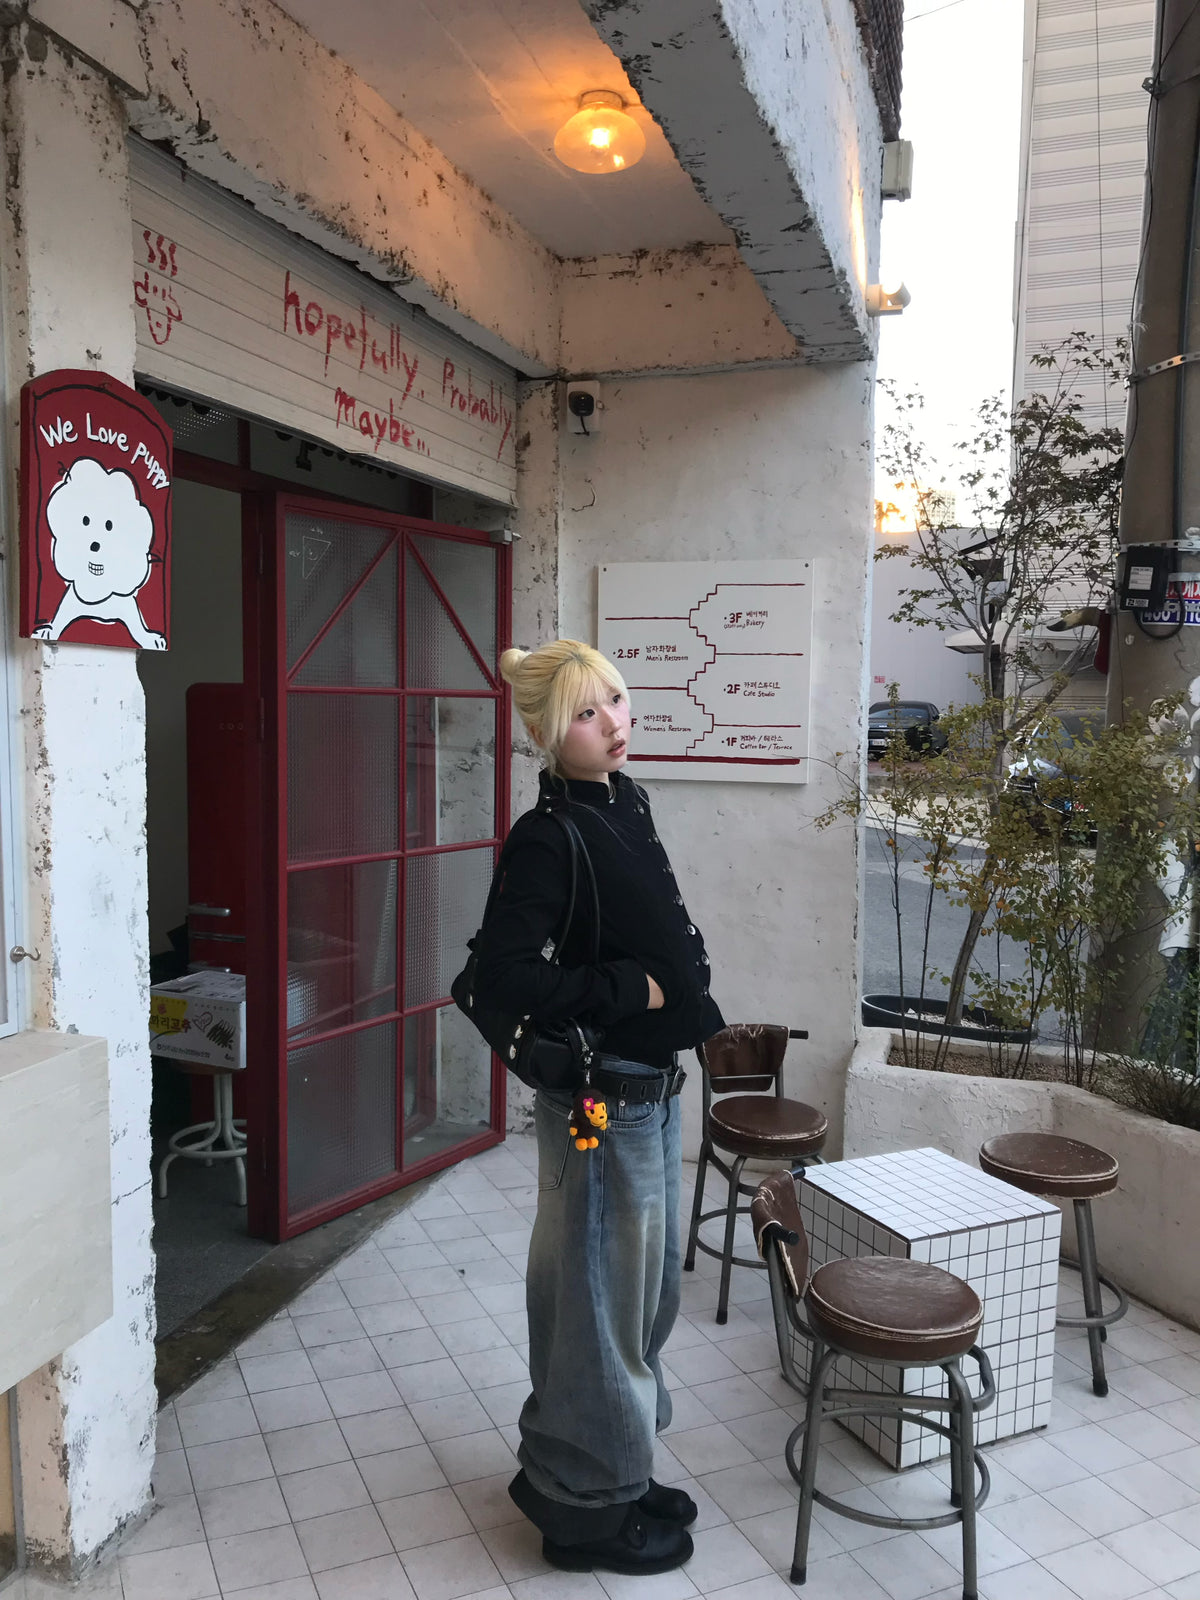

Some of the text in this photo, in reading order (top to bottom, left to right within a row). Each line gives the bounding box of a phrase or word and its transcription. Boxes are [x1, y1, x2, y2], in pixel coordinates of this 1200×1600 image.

[441, 356, 513, 459] Probably
[39, 415, 79, 448] We
[85, 412, 130, 452] Love
[729, 612, 743, 624] 3F
[746, 610, 769, 618] 베이커리
[746, 619, 765, 629] Bakery
[616, 648, 640, 659] 2.5F
[645, 645, 677, 653] 남자화장실
[726, 683, 741, 694] 2F
[758, 690, 775, 698] Studio
[643, 714, 673, 722] 여자화장실
[668, 724, 692, 732] Restroom
[726, 737, 738, 747] 1F
